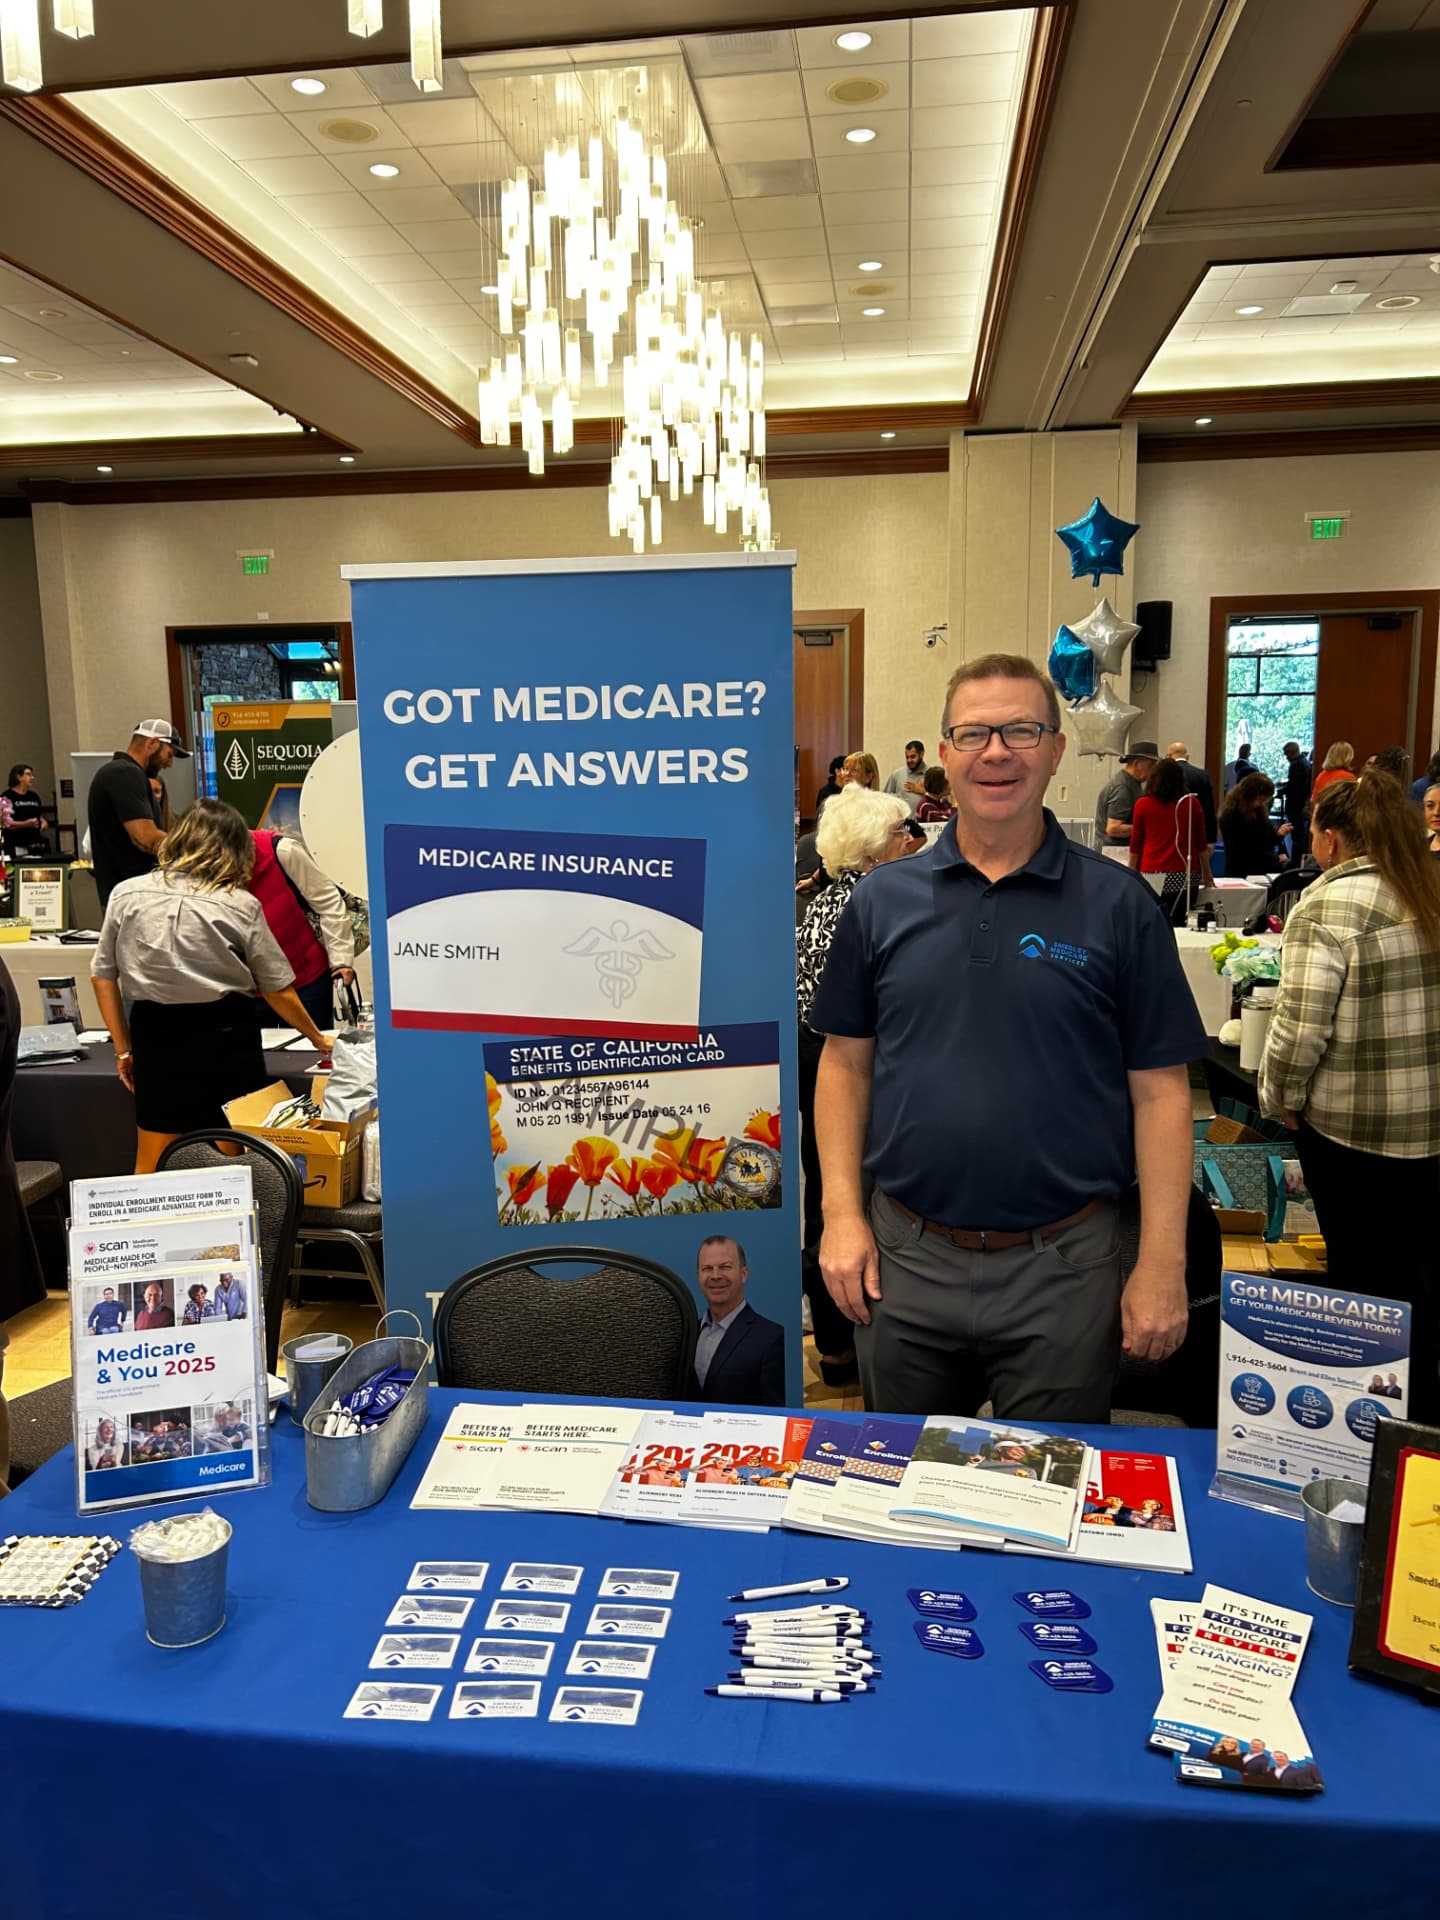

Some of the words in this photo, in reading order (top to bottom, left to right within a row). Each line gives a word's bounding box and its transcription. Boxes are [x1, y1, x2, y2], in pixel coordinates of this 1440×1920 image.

[1314, 519, 1341, 538] EXIT
[244, 556, 268, 574] EXIT
[383, 687, 480, 724] GOT
[493, 680, 768, 722] MEDICARE?
[257, 744, 321, 761] SEQUOIA
[405, 753, 496, 789] GET
[507, 748, 749, 788] ANSWERS
[418, 847, 535, 873] MEDICARE
[541, 854, 674, 878] INSURANCE
[394, 941, 440, 958] JANE
[444, 943, 500, 961] SMITH
[510, 1045, 563, 1063] STATE
[570, 1042, 596, 1058] OF
[512, 1062, 572, 1076] BENEFITS
[577, 1053, 682, 1071] IDENTIFICATION
[686, 1050, 725, 1063] CARD
[514, 1088, 527, 1099] ID
[530, 1087, 549, 1098] No.
[552, 1079, 649, 1096] 01234567A96144
[516, 1101, 549, 1113] JOHN
[552, 1100, 562, 1111] Q
[565, 1095, 630, 1110] RECIPIENT
[517, 1118, 527, 1128] M
[530, 1116, 544, 1127] 05
[547, 1115, 561, 1126] 20
[565, 1113, 591, 1124] 1991
[598, 1110, 630, 1121] Issue
[633, 1108, 659, 1119] Date
[662, 1106, 676, 1117] 05
[680, 1105, 693, 1116] 24
[697, 1103, 711, 1114] 16
[89, 1200, 124, 1210] INDIVIDUAL
[126, 1196, 166, 1206] ENROLLMENT
[168, 1193, 195, 1202] REQUEST
[197, 1192, 213, 1200] FORM
[89, 1209, 113, 1218] ENROLL
[129, 1204, 160, 1214] MEDICARE
[162, 1202, 197, 1212] ADVANTAGE
[199, 1200, 214, 1208] PLAN
[215, 1198, 232, 1207] (PART
[233, 1197, 240, 1205] C)
[99, 1240, 129, 1252] scan
[84, 1255, 119, 1265] MEDICARE
[120, 1253, 140, 1262] MADE
[141, 1252, 155, 1260] FOR
[1230, 1279, 1267, 1300] Got
[1272, 1286, 1403, 1325] MEDICARE?
[1230, 1297, 1248, 1307] GET
[1249, 1299, 1274, 1312] YOUR
[1275, 1305, 1324, 1321] MEDICARE
[1324, 1314, 1363, 1329] REVIEW
[1364, 1322, 1401, 1337] TODAY!
[97, 1341, 196, 1365] Medicare
[1231, 1353, 1287, 1373] 916-425-5604
[97, 1369, 112, 1384] &
[118, 1365, 158, 1381] You
[164, 1356, 216, 1376] 2025
[460, 1430, 500, 1438] STARTS
[524, 1430, 561, 1438] STARTS
[527, 1424, 562, 1432] BETTER
[563, 1425, 618, 1433] MEDICARE
[468, 1445, 503, 1453] scan
[698, 1443, 780, 1474] 2026
[864, 1448, 912, 1461] Enrollme
[199, 1462, 246, 1476] Medicare
[1222, 1602, 1249, 1617] IT'S
[1252, 1611, 1290, 1629] TIME
[1413, 1615, 1436, 1628] Best
[1208, 1622, 1292, 1650] MEDICARE
[1211, 1613, 1241, 1627] FOR
[1250, 1622, 1294, 1641] YOUR
[1203, 1632, 1289, 1659] REVIEW
[1189, 1646, 1292, 1679] CHANGING?
